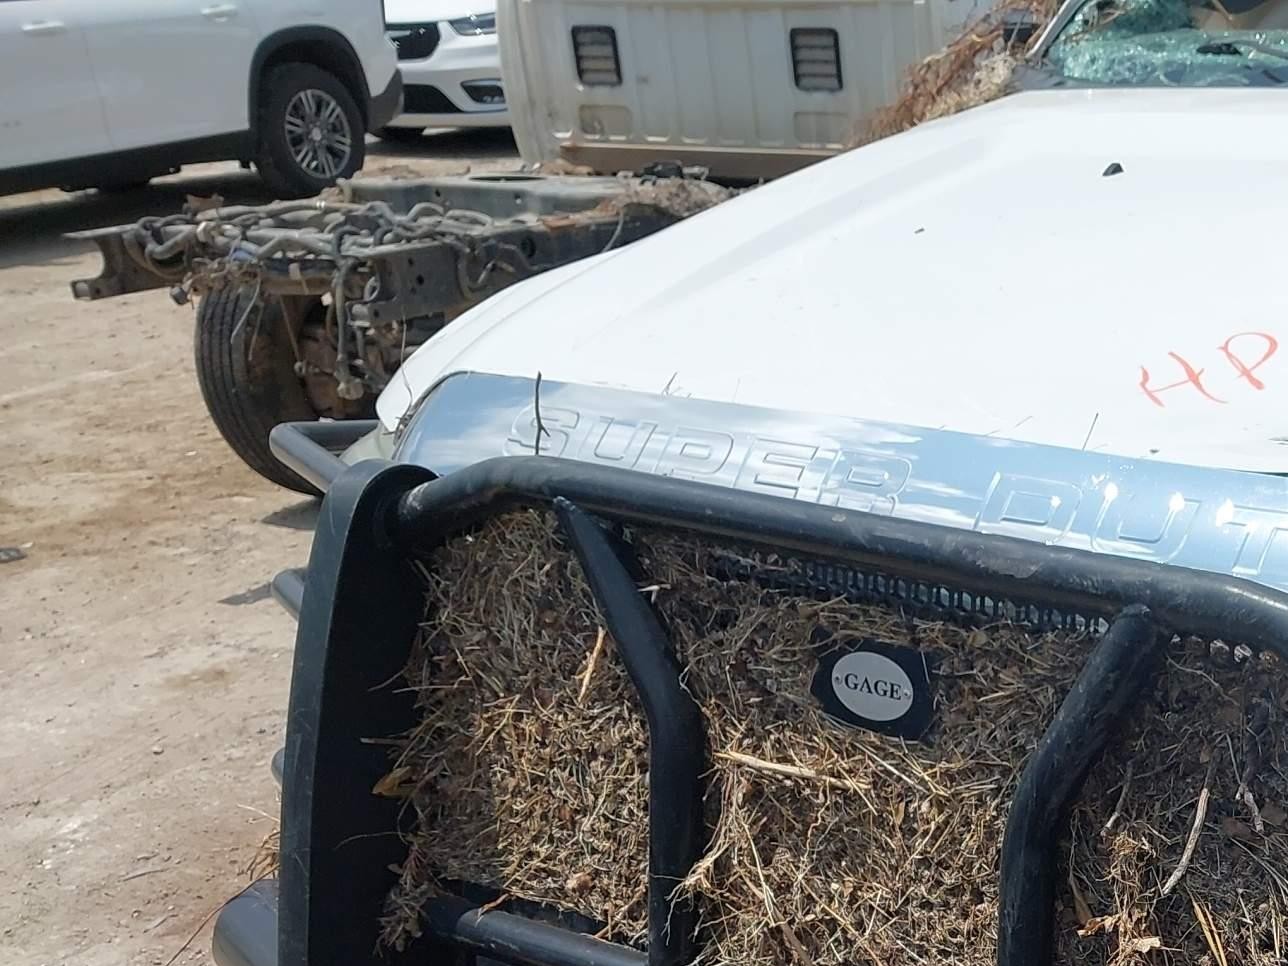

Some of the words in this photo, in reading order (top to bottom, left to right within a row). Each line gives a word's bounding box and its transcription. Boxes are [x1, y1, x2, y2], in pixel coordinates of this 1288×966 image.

[1139, 331, 1279, 408] HP
[502, 404, 914, 518] SUPER
[843, 672, 902, 701] GAGE
